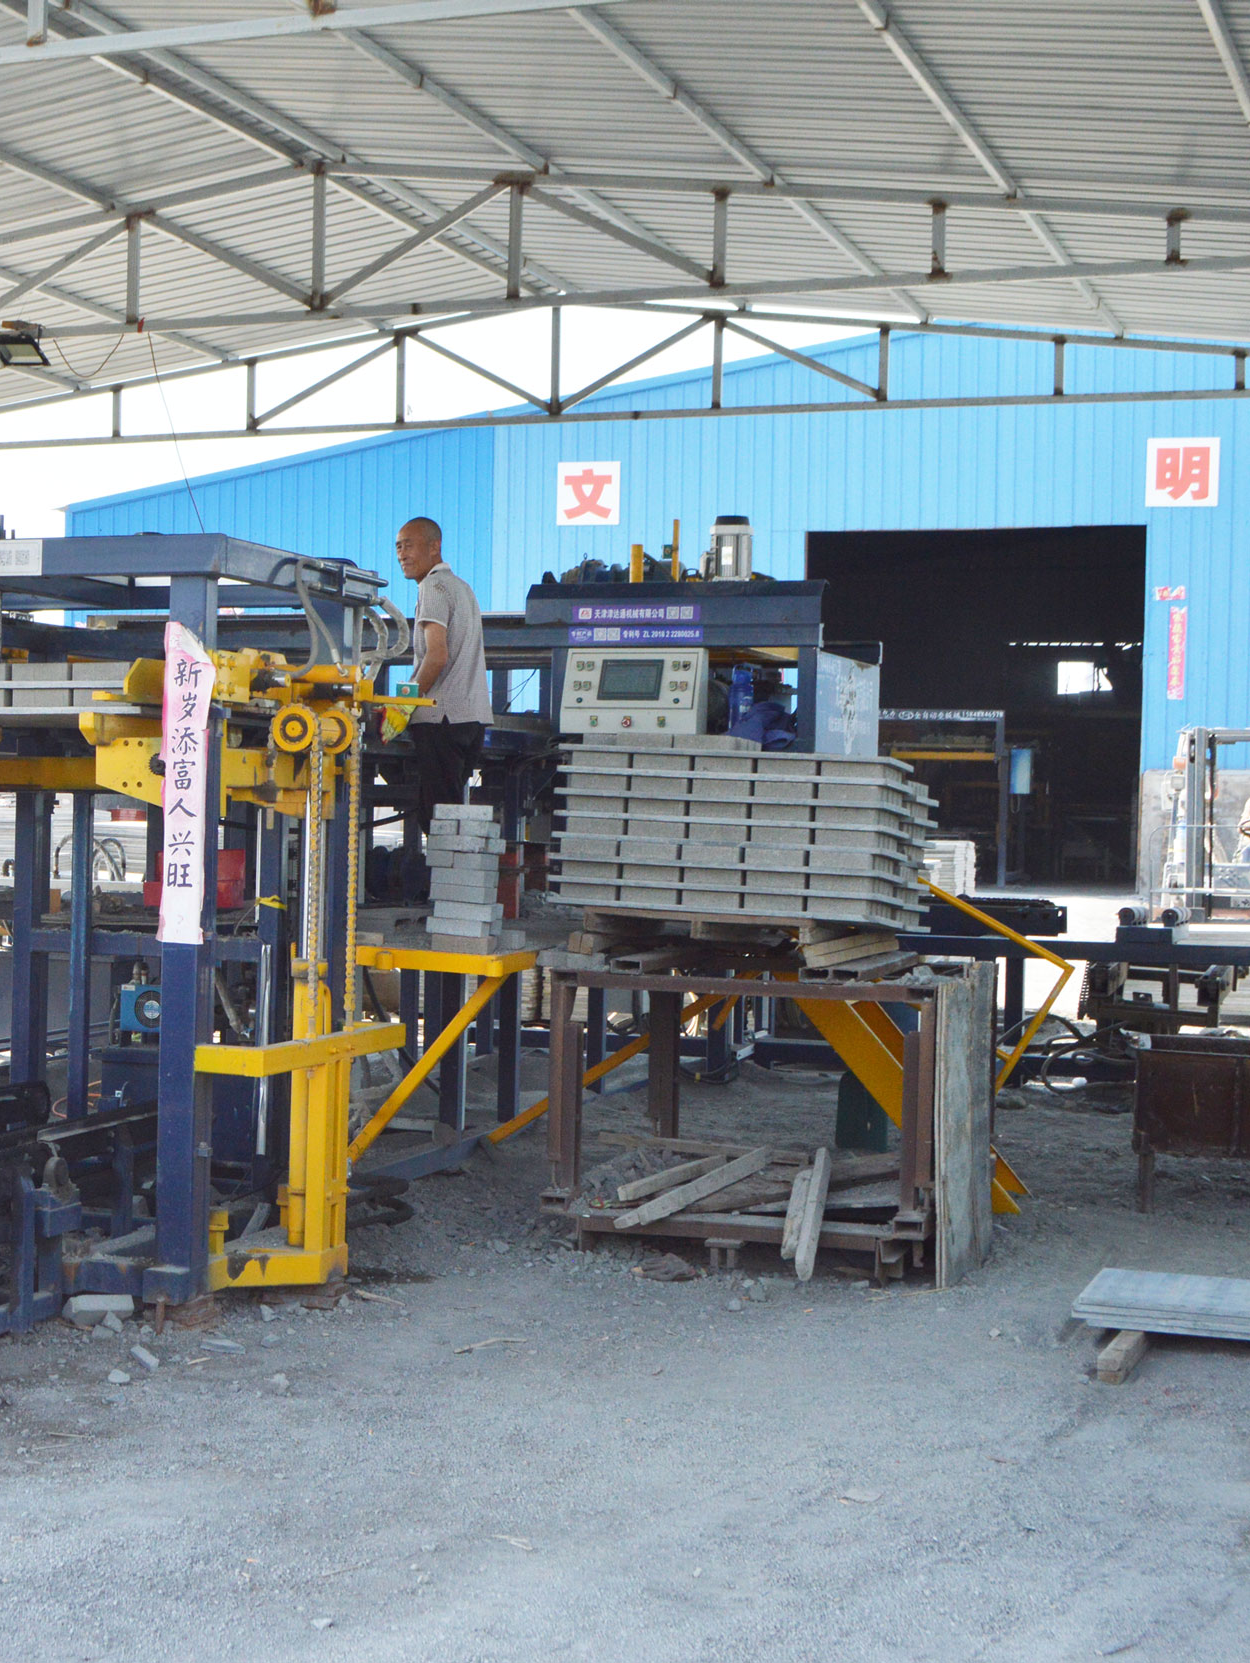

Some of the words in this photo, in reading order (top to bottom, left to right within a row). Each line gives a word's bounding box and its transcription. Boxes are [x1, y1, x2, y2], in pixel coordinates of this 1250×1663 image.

[563, 468, 613, 520] 文
[1155, 446, 1210, 501] 明
[167, 659, 202, 888] 新岁添富人兴旺
